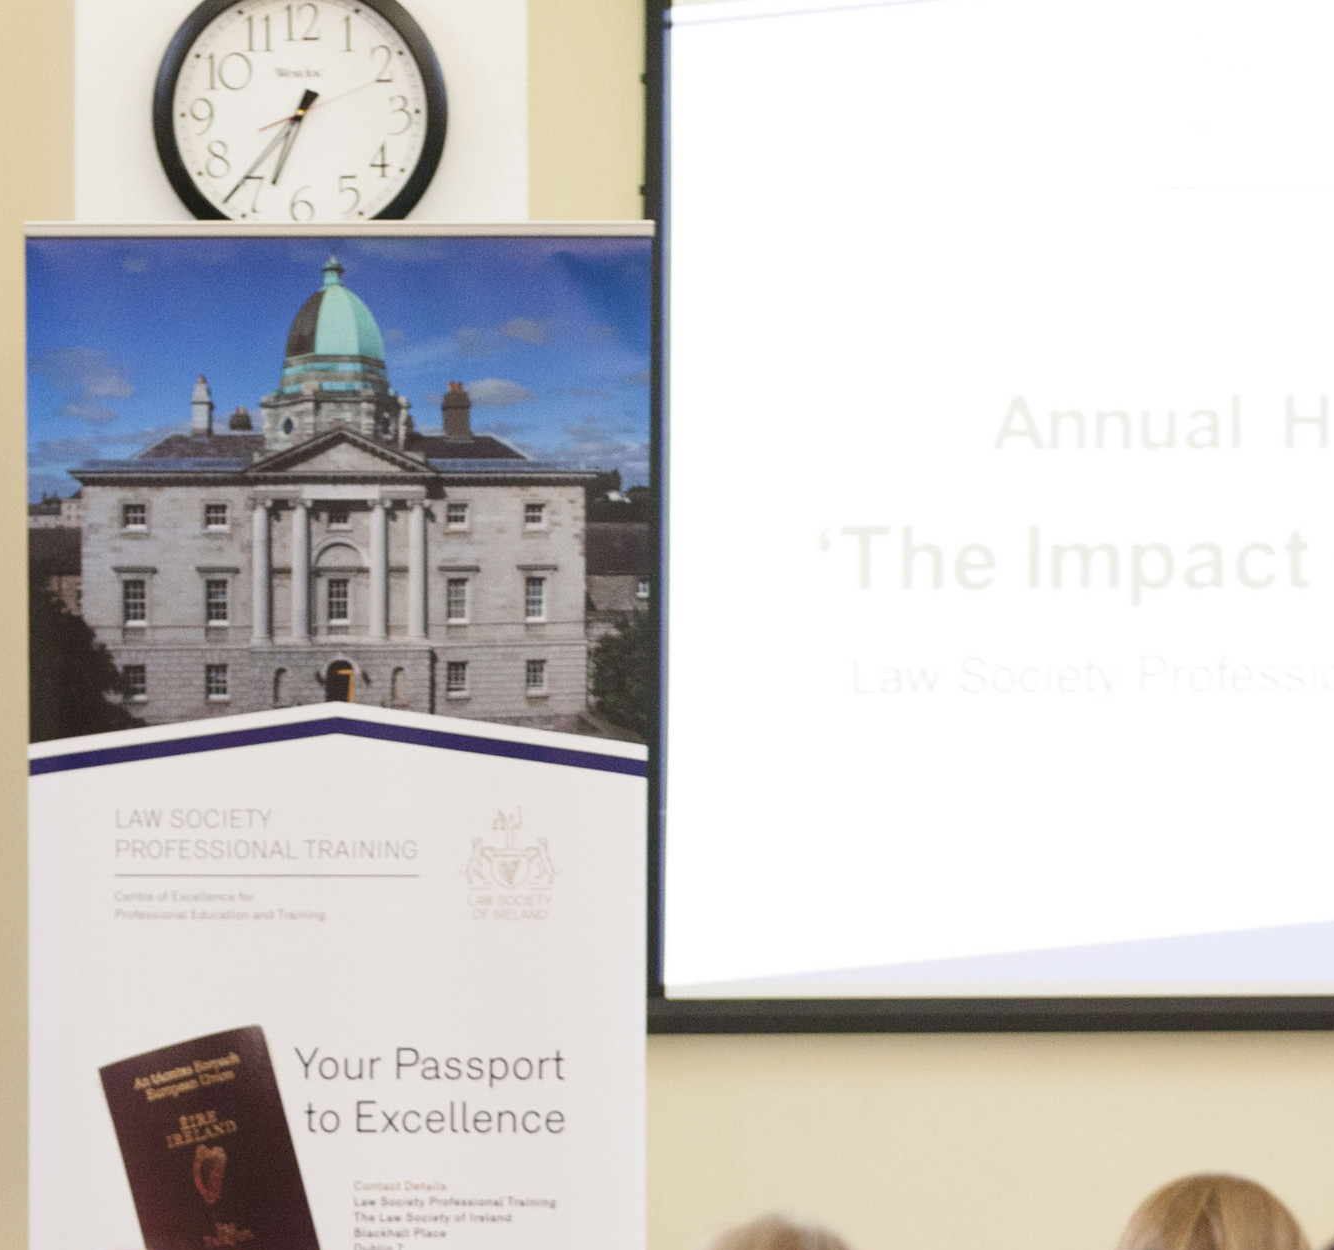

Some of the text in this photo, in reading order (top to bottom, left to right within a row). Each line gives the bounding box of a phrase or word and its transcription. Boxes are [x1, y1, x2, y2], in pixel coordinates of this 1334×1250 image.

[246, 15, 272, 52] 11
[282, 3, 319, 41] 12
[342, 15, 353, 52] 1
[207, 52, 253, 90] 10
[370, 45, 393, 83] 2
[189, 98, 214, 136] 9
[389, 95, 413, 135] 3
[205, 140, 230, 179] 8
[370, 140, 391, 178] 4
[245, 175, 264, 213] 7
[290, 185, 315, 220] 6
[339, 174, 361, 214] 5
[992, 394, 1242, 451] Annual
[1027, 525, 1311, 608] Impact
[852, 656, 940, 697] Law
[958, 655, 1118, 703] Society
[115, 808, 272, 830] LAW SOCIETY
[115, 838, 418, 861] PROFESSIONAL TRAINING
[114, 890, 254, 903] Centre of Excellence for
[114, 908, 326, 923] Professional Education and Training
[293, 1046, 566, 1089] Your Passport
[303, 1100, 566, 1135] to Excellence
[352, 1180, 448, 1192] Contact Details
[353, 1196, 557, 1210] Law Society Professional Training
[353, 1212, 513, 1225] The Law Society of Ireland
[353, 1227, 447, 1239] Blackhall Place
